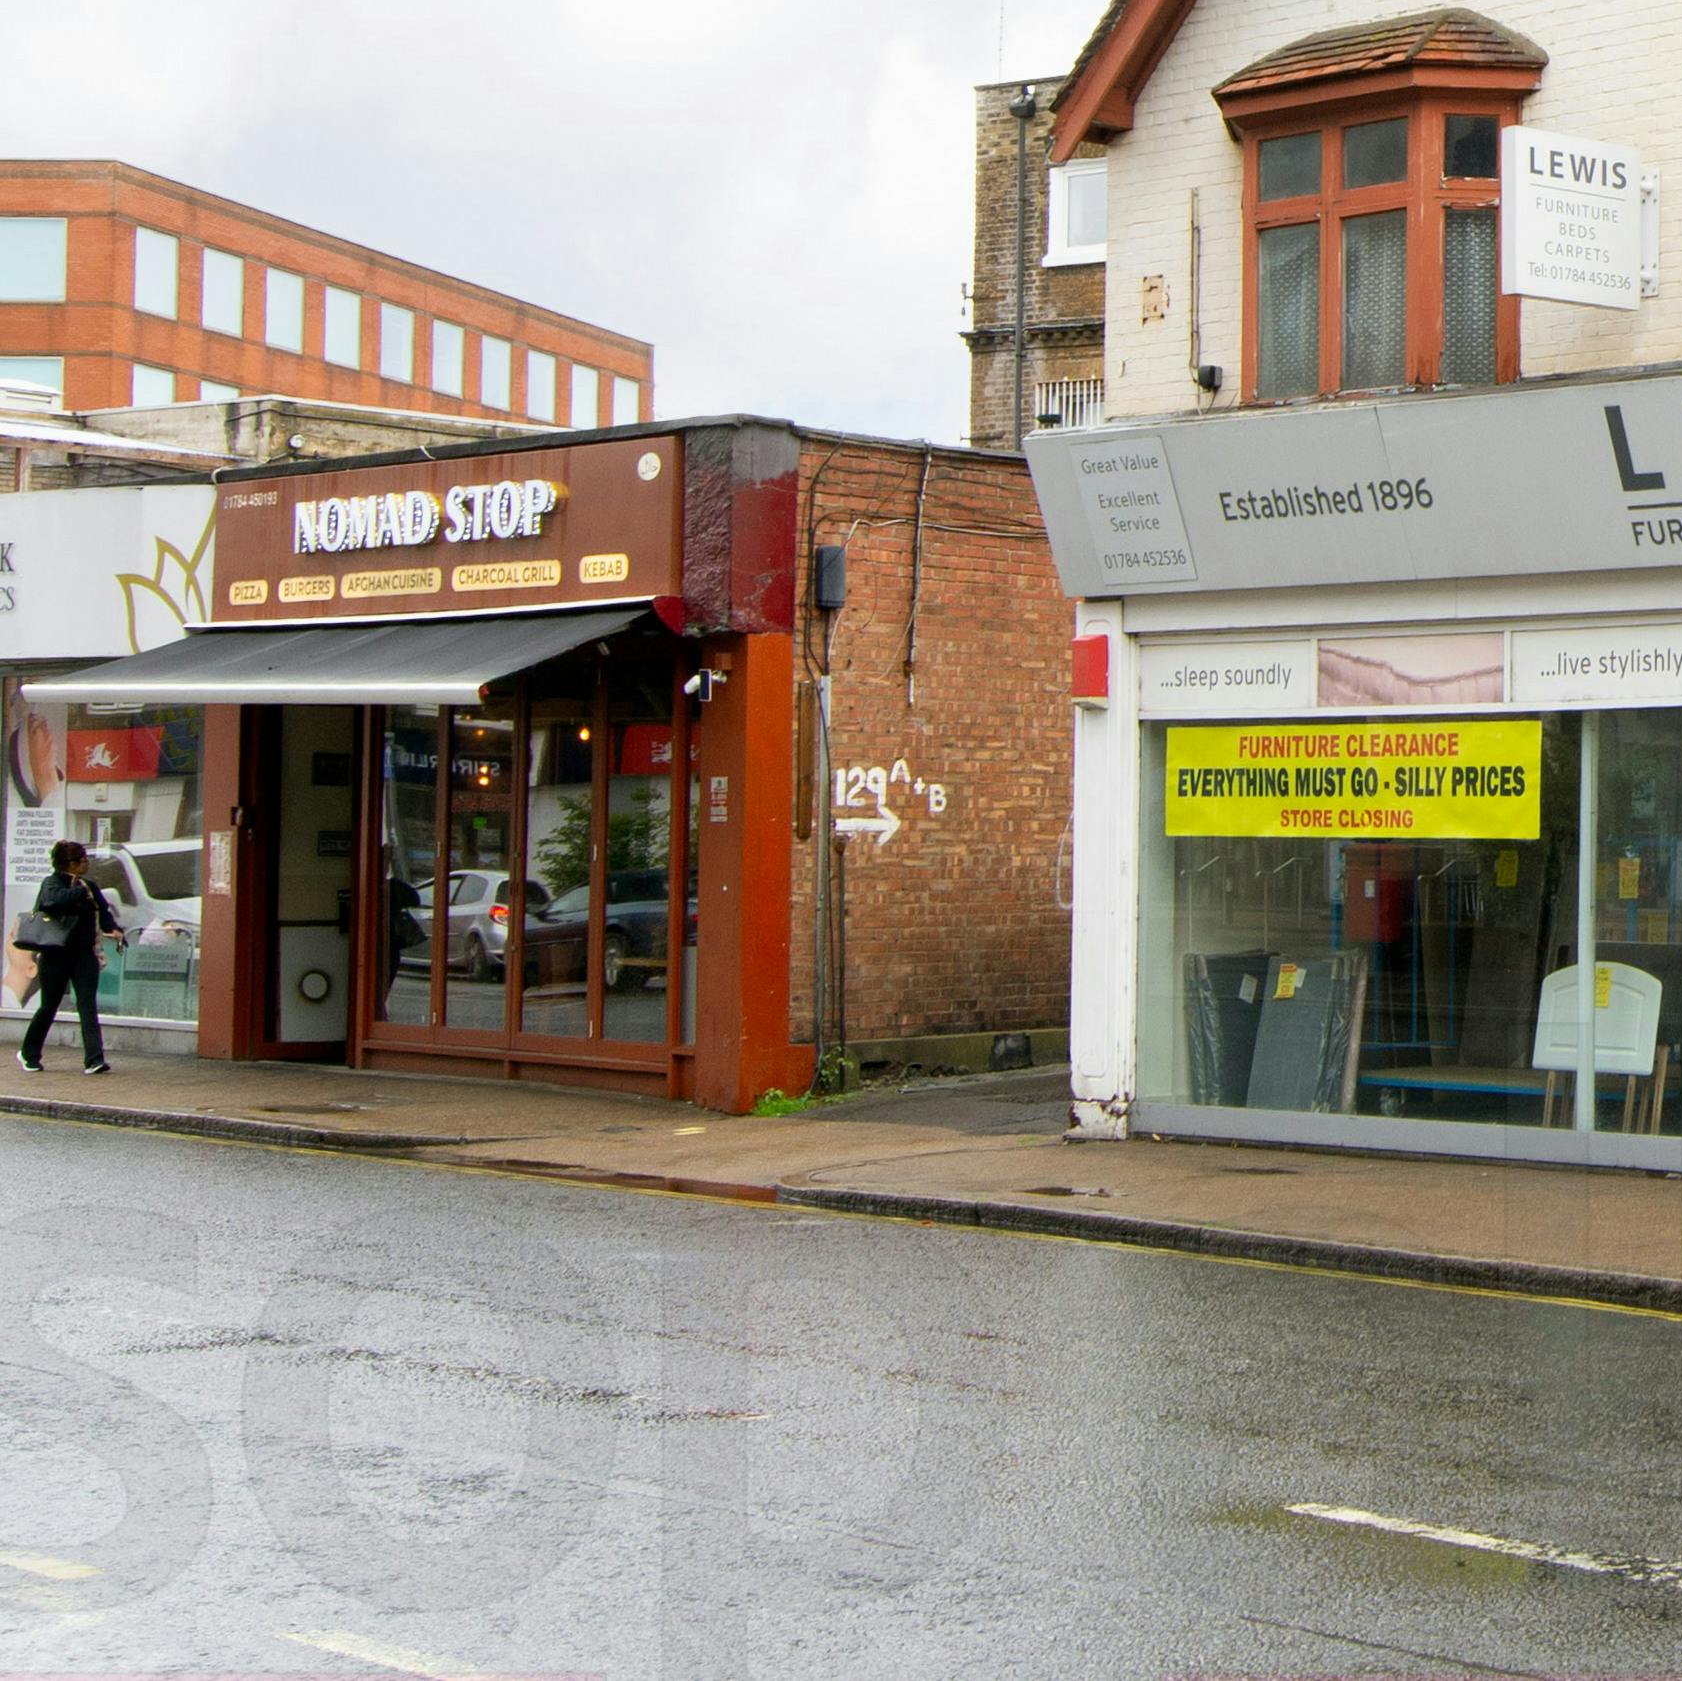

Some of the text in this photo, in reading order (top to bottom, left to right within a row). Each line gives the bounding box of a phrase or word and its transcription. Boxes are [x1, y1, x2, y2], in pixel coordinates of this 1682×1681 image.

[1529, 146, 1628, 190] LEWIS
[1536, 197, 1620, 223] FURNITURE
[1559, 222, 1597, 240] BEDS
[1544, 241, 1611, 263] CARPETS
[1528, 261, 1632, 290] Tel: 01784 452536
[1081, 454, 1160, 475] Great Value
[1098, 492, 1161, 509] Excellent
[1219, 477, 1434, 522] Established 1896
[293, 478, 560, 555] NOMAD STOP
[1110, 517, 1161, 533] Service
[582, 559, 625, 579] KEBAB
[1104, 549, 1187, 570] 01784 452536
[346, 570, 435, 594] AFGHAN CUISINE
[457, 561, 556, 586] CHARCOAL GRILL
[233, 584, 264, 602] PIZZA
[282, 580, 331, 598] BURGERS
[1540, 651, 1592, 679] ...live
[1160, 662, 1293, 693] ...sleep soundly
[1239, 733, 1459, 759] FURNITURE CLEARANCE
[836, 766, 887, 807] 129
[1177, 768, 1289, 797] EVERYTHING
[1295, 767, 1347, 797] MUST
[1350, 767, 1378, 796] GO
[1394, 766, 1446, 796] SILLY
[1451, 765, 1526, 796] PRICES
[1279, 810, 1414, 829] STORE CLOSING
